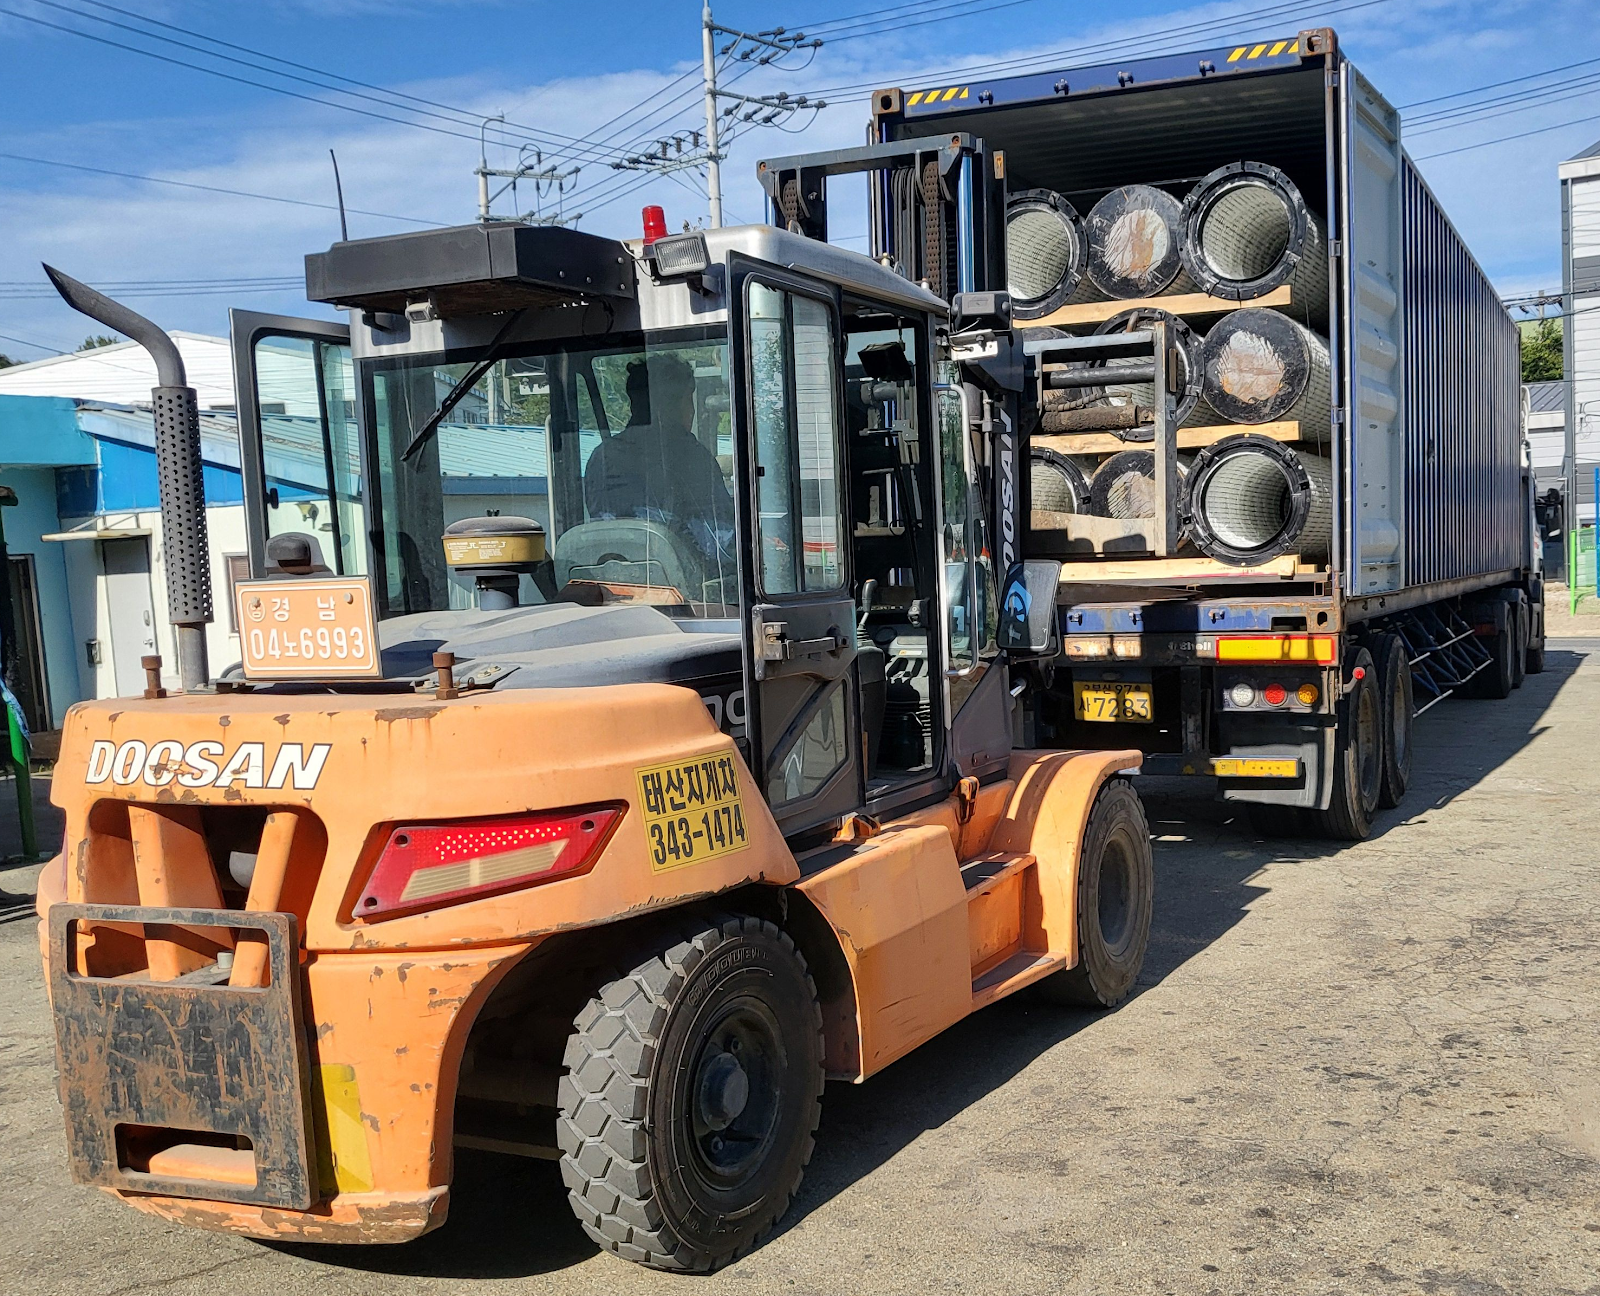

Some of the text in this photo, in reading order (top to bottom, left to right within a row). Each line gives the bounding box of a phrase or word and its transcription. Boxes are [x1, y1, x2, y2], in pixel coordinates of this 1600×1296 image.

[250, 626, 366, 660] 04노6993
[84, 739, 333, 790] DOOSAN
[642, 757, 737, 815] 태산지게차
[650, 804, 746, 865] 343-1474
